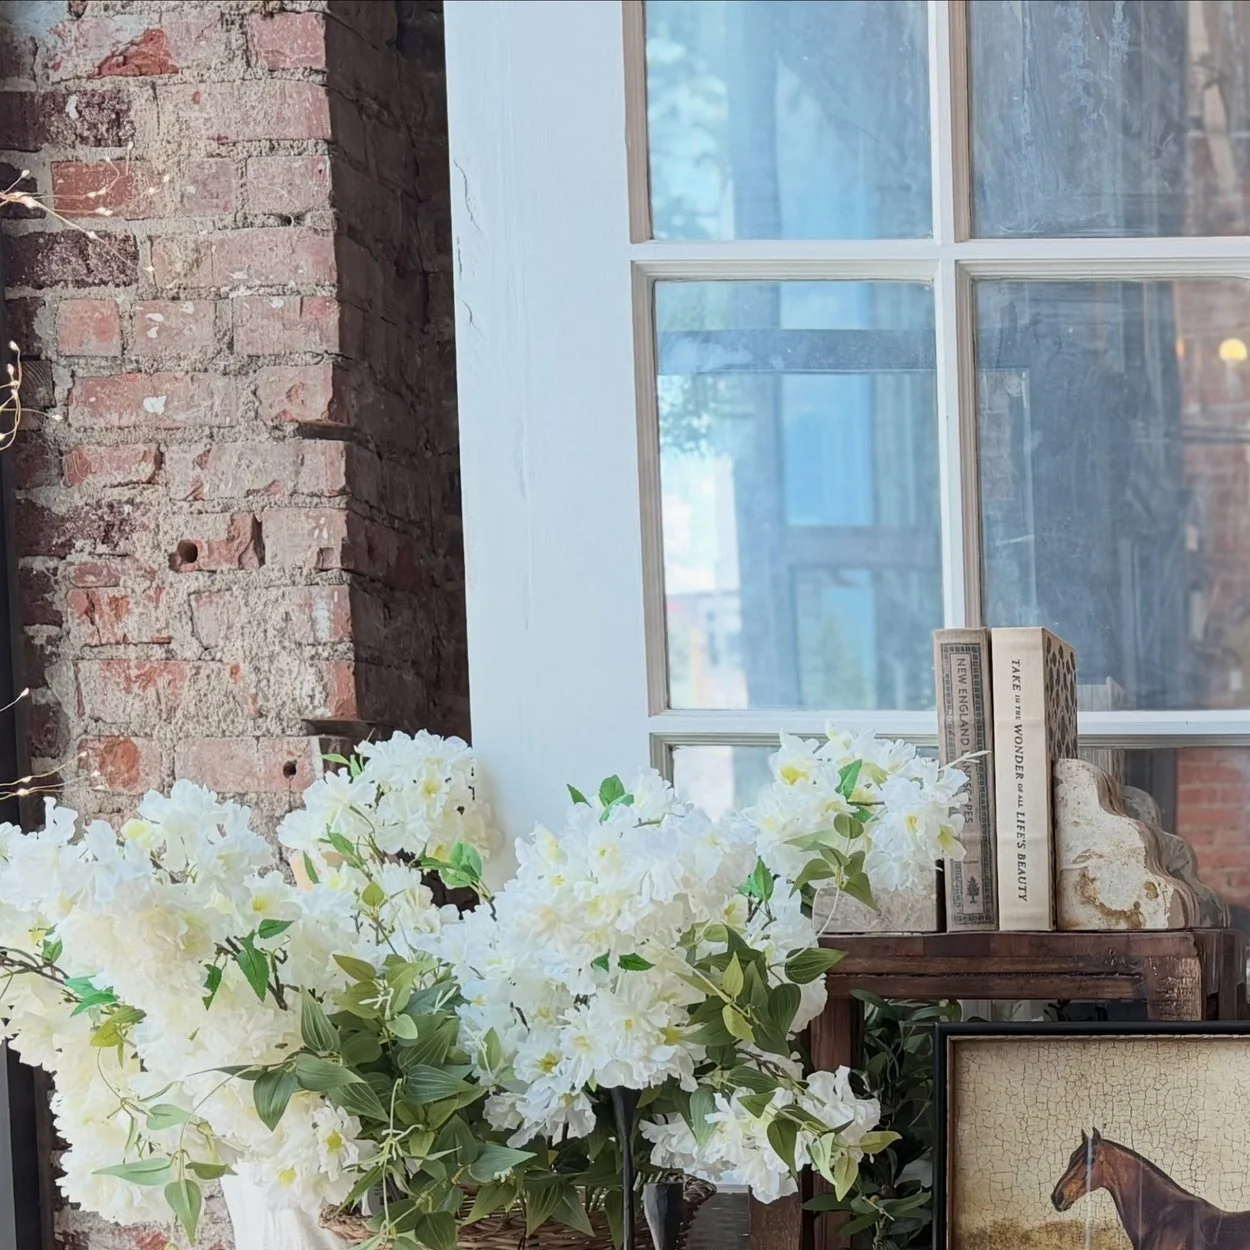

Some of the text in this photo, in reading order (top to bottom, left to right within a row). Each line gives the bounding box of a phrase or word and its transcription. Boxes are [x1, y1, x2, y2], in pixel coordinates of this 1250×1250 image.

[1011, 659, 1021, 691] TAKE
[1014, 694, 1021, 704] IN
[956, 658, 974, 824] NEW ENGLAND LNSCPES
[1013, 724, 1024, 780] WONDER
[1017, 783, 1024, 793] OF
[1016, 812, 1026, 849] LIFE'S
[1017, 853, 1028, 902] BEAUTY
